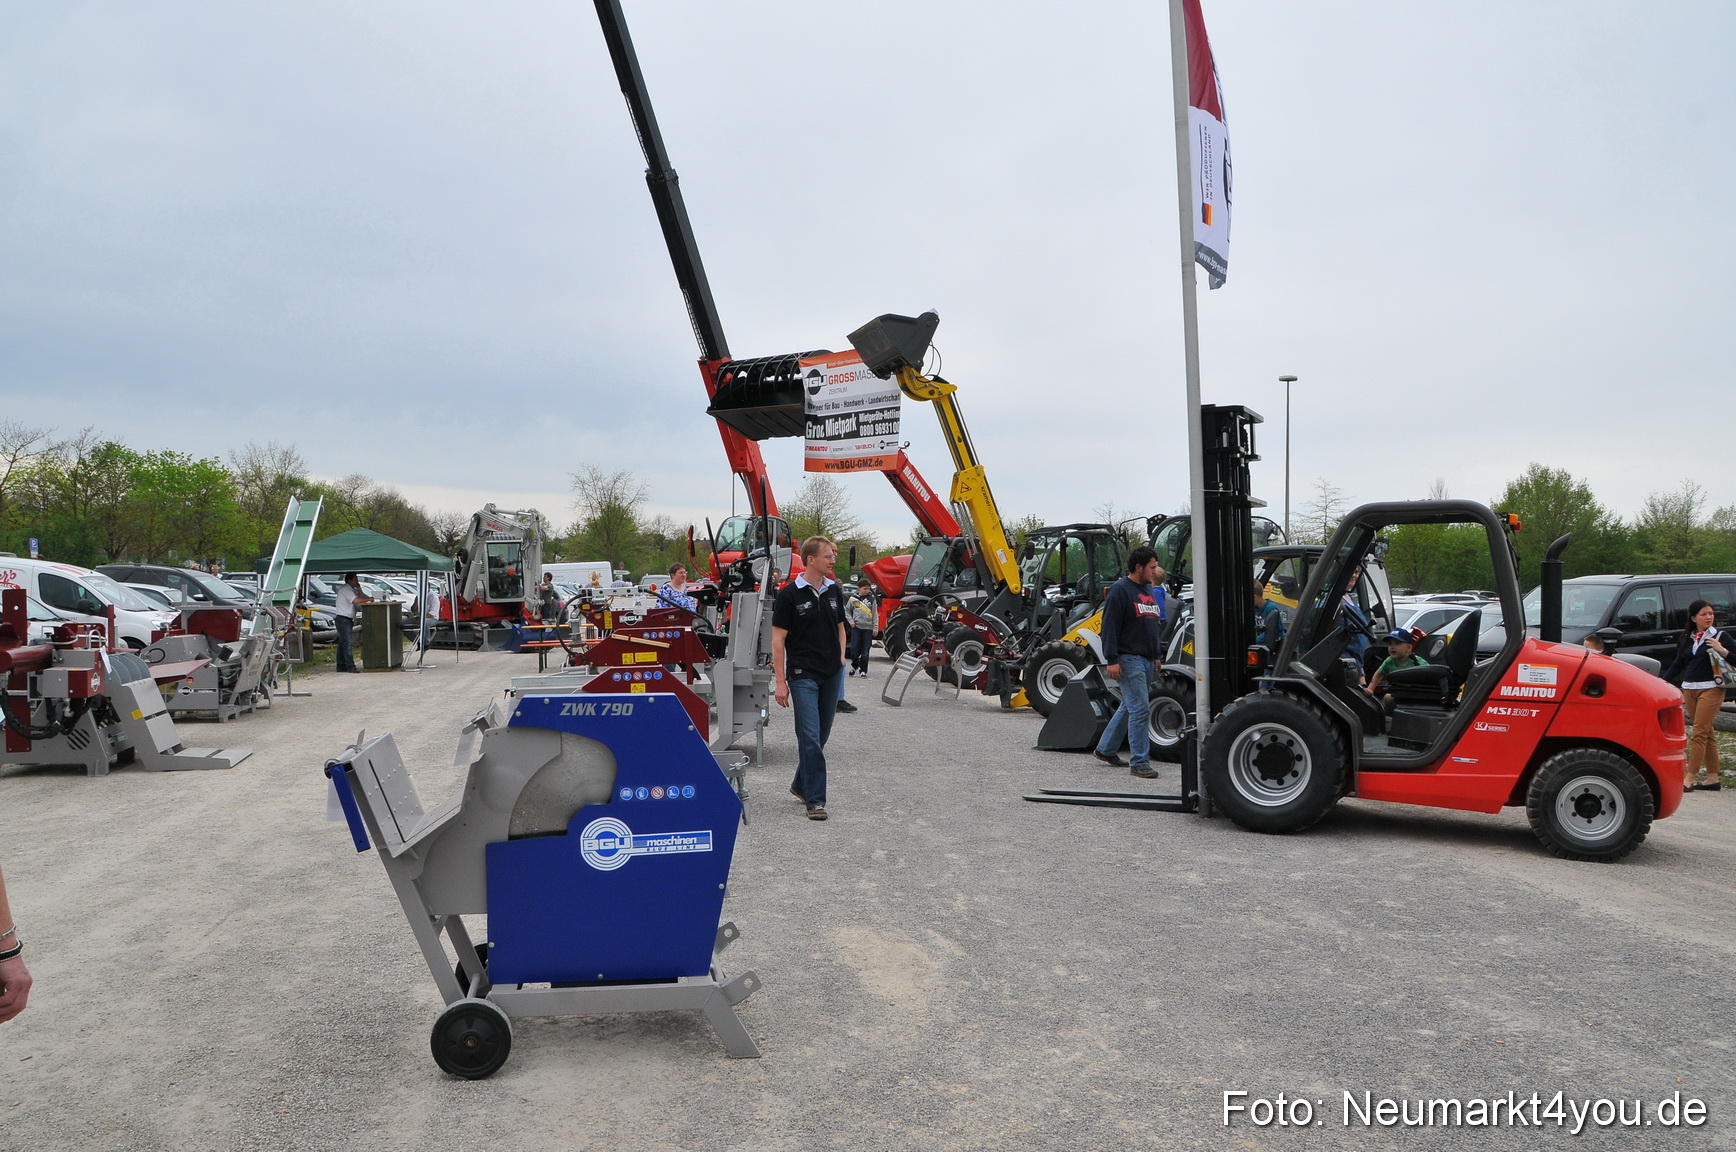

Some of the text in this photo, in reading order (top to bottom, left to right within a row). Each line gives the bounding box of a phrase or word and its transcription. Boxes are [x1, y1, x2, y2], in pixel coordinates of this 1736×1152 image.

[832, 402, 840, 410] Bau
[844, 397, 864, 408] Handwerk
[826, 414, 857, 438] Mietpark
[860, 424, 874, 436] 0800
[903, 466, 930, 502] MANITOU
[1500, 686, 1556, 698] MANITOU
[560, 703, 634, 716] ZWK 790
[583, 836, 697, 850] BGU maschinen
